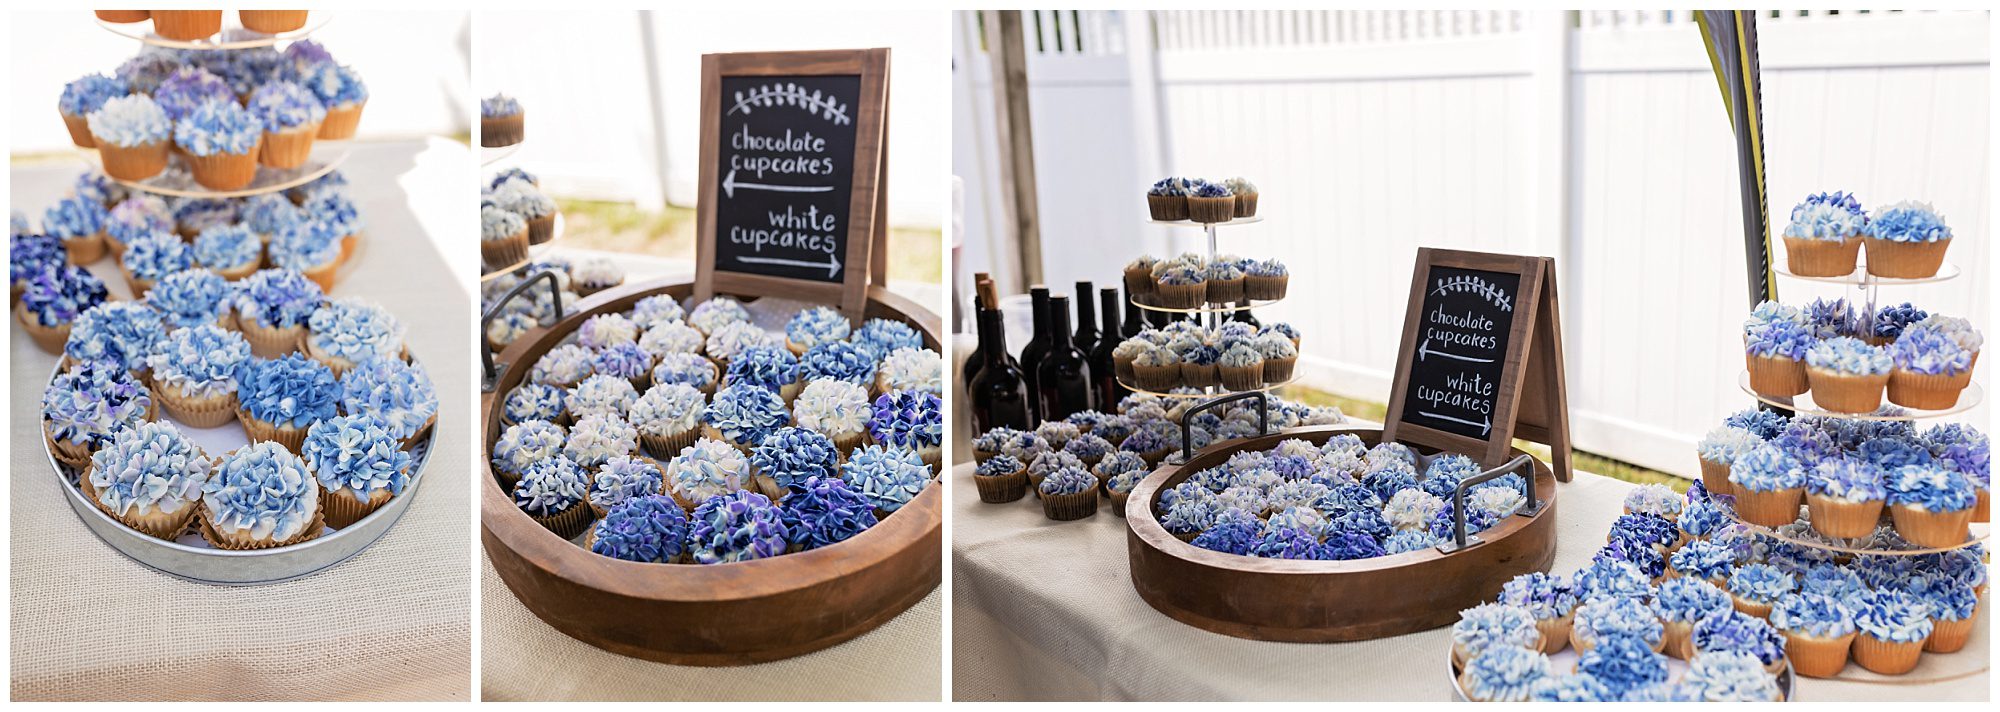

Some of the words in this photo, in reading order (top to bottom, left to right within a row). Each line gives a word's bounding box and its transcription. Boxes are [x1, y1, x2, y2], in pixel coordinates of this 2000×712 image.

[732, 123, 825, 152] chocolate
[731, 154, 834, 179] cupcakes
[768, 205, 836, 232] white
[730, 226, 836, 253] cupcakes
[1430, 303, 1494, 331] chocolate
[1427, 327, 1496, 349] cupcakes
[1446, 372, 1492, 396] white
[1417, 385, 1490, 414] cupcakes
